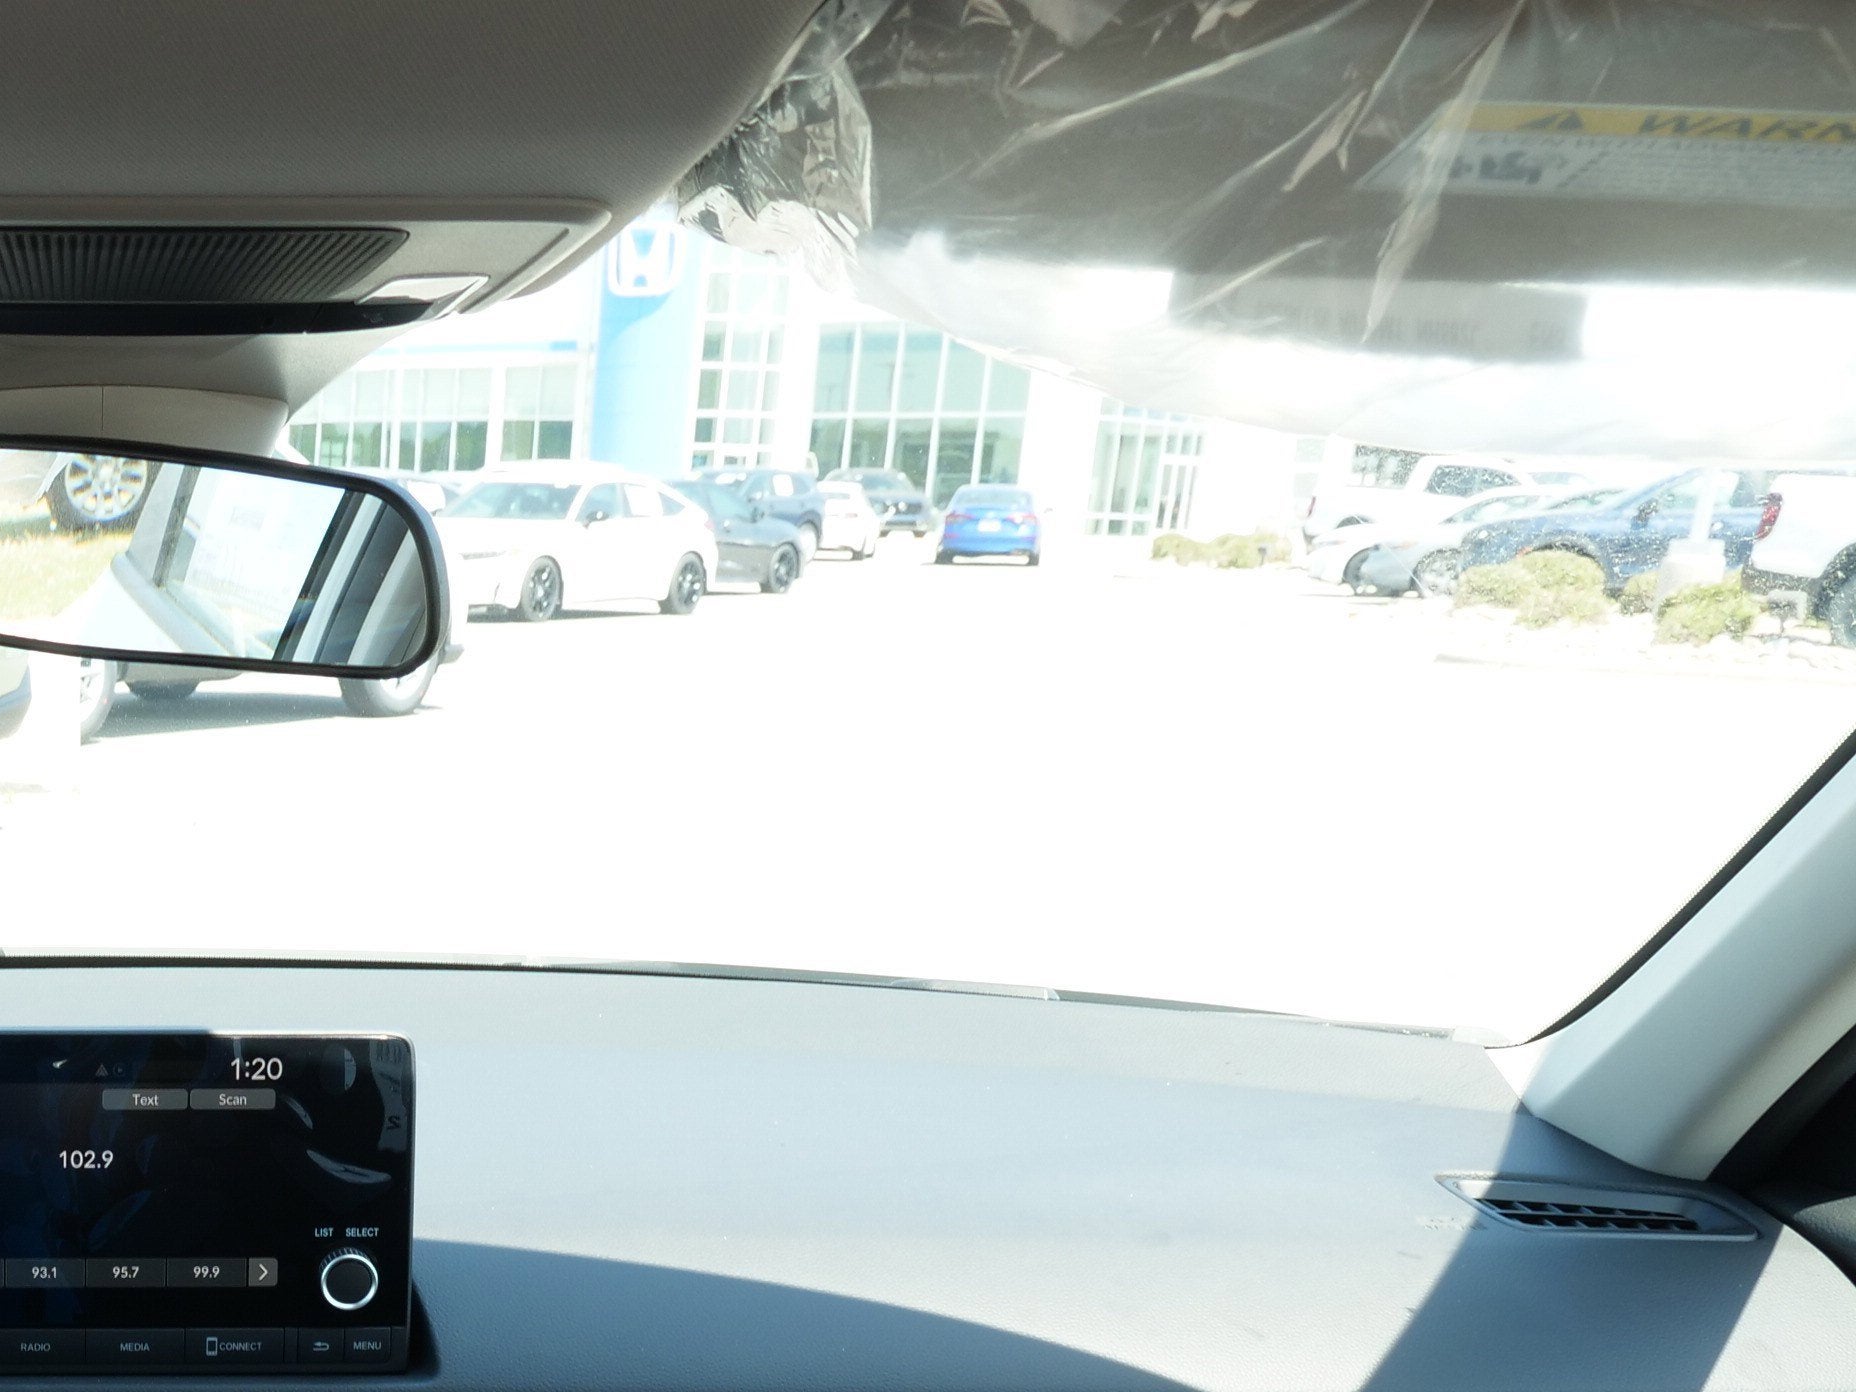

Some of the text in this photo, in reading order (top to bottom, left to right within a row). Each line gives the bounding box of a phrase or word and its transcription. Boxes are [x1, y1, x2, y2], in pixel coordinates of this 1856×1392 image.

[230, 1057, 283, 1081] 1:20
[132, 1093, 159, 1106] Text
[218, 1092, 247, 1106] Scan
[58, 1149, 114, 1169] 102.9
[314, 1227, 380, 1238] LIST SELECT
[31, 1266, 58, 1279] 93.1
[112, 1266, 140, 1279] 95.7
[193, 1265, 220, 1279] 99.9
[20, 1342, 51, 1352] RADIO
[119, 1341, 151, 1352] MEDIA
[219, 1341, 262, 1351] CONNECT
[353, 1341, 382, 1351] MENU
